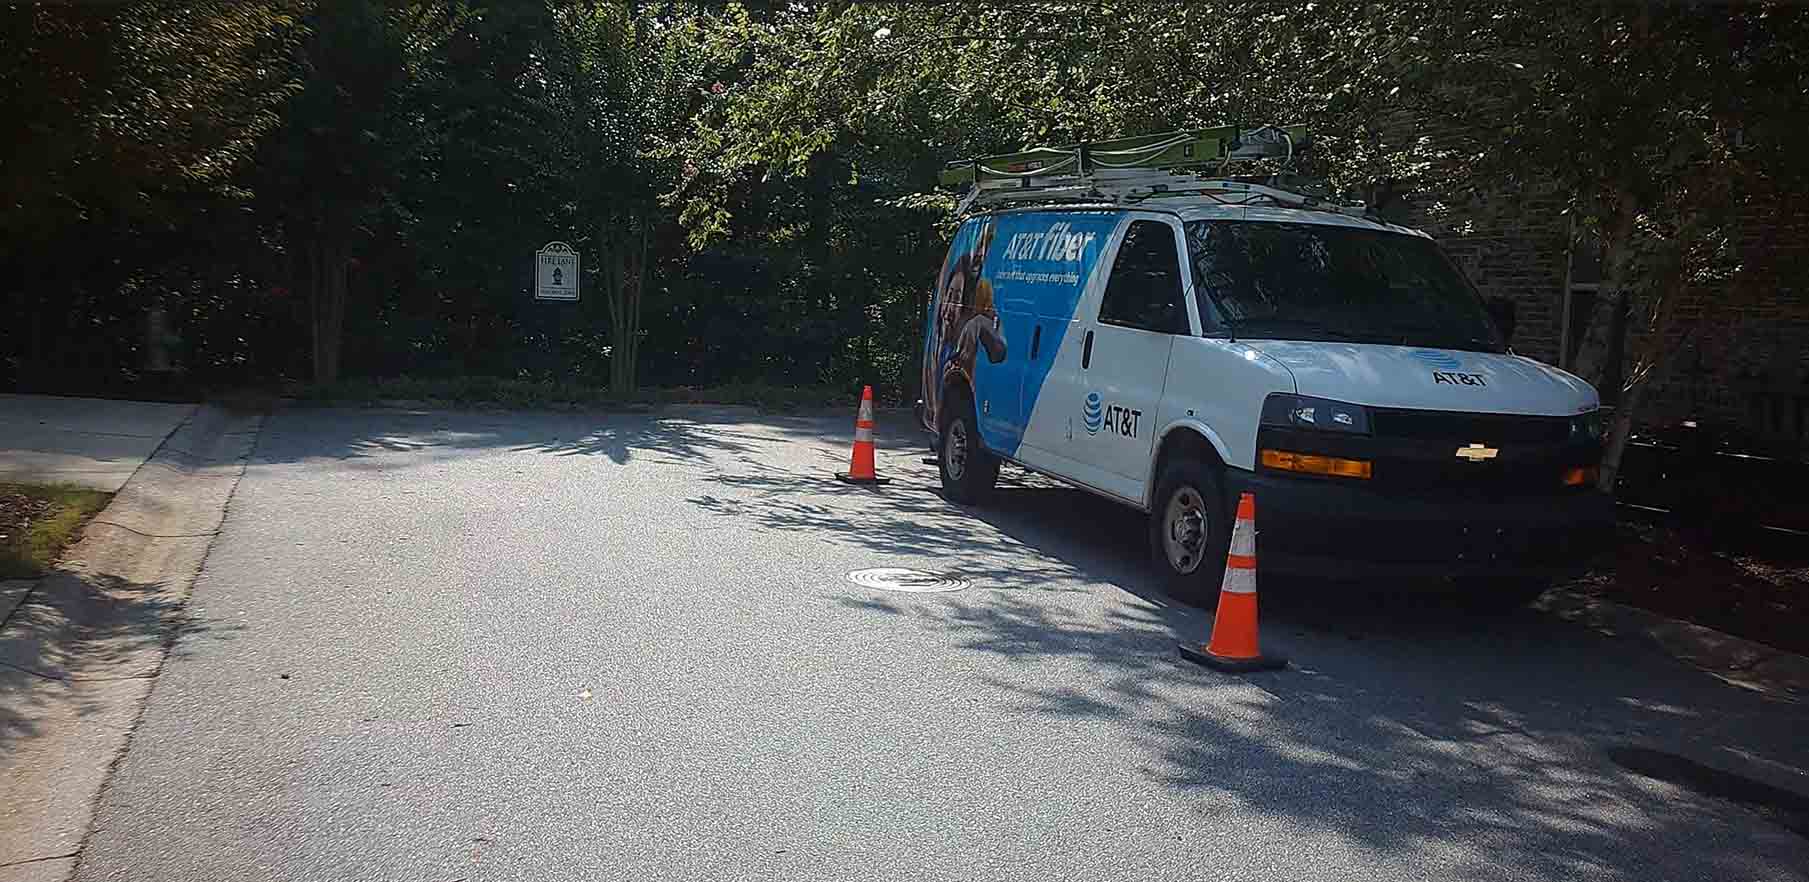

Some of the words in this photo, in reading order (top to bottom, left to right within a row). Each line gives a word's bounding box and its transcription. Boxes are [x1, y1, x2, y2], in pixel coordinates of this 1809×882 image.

[1002, 232, 1045, 260] AT&T
[1039, 222, 1096, 262] fiber
[1048, 271, 1079, 287] everything
[1432, 371, 1487, 387] AT&T
[1103, 404, 1142, 438] AT&T
